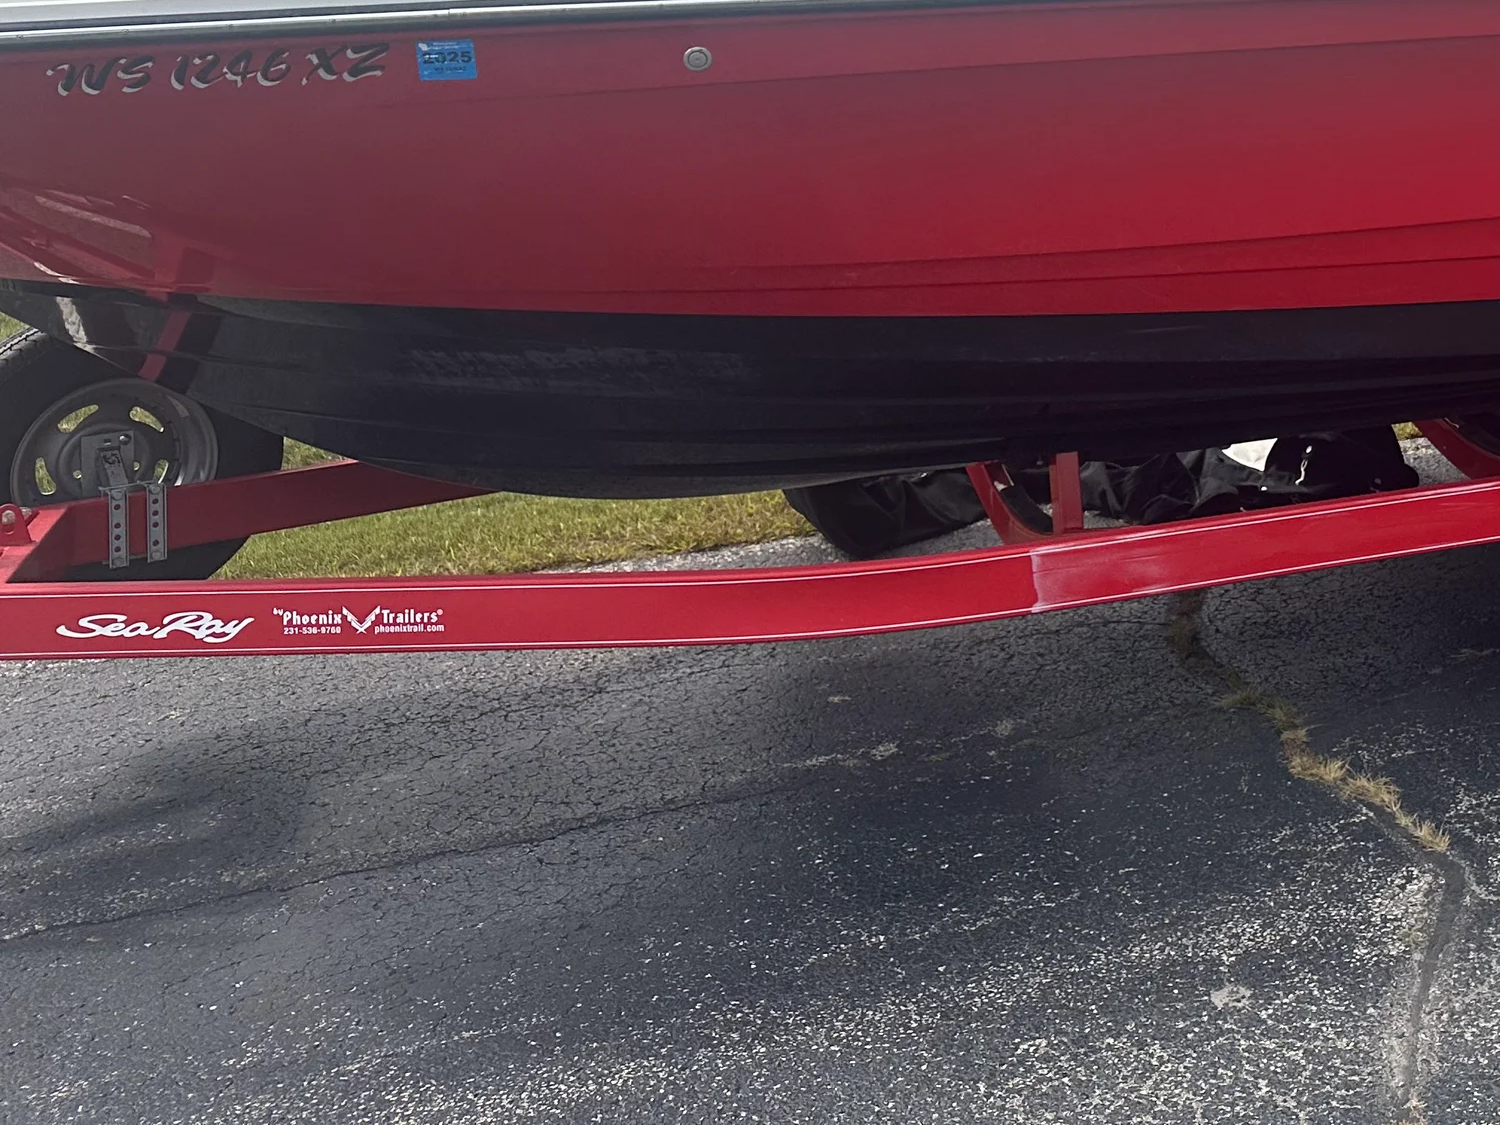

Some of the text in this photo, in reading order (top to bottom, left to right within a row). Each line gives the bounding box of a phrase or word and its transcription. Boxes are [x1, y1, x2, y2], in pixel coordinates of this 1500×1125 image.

[422, 50, 472, 65] 2025
[46, 41, 391, 97] WS 1246 XZ
[283, 609, 343, 626] Phoenix
[56, 610, 255, 644] Sea Ray
[374, 624, 445, 635] phoenixtrail.com
